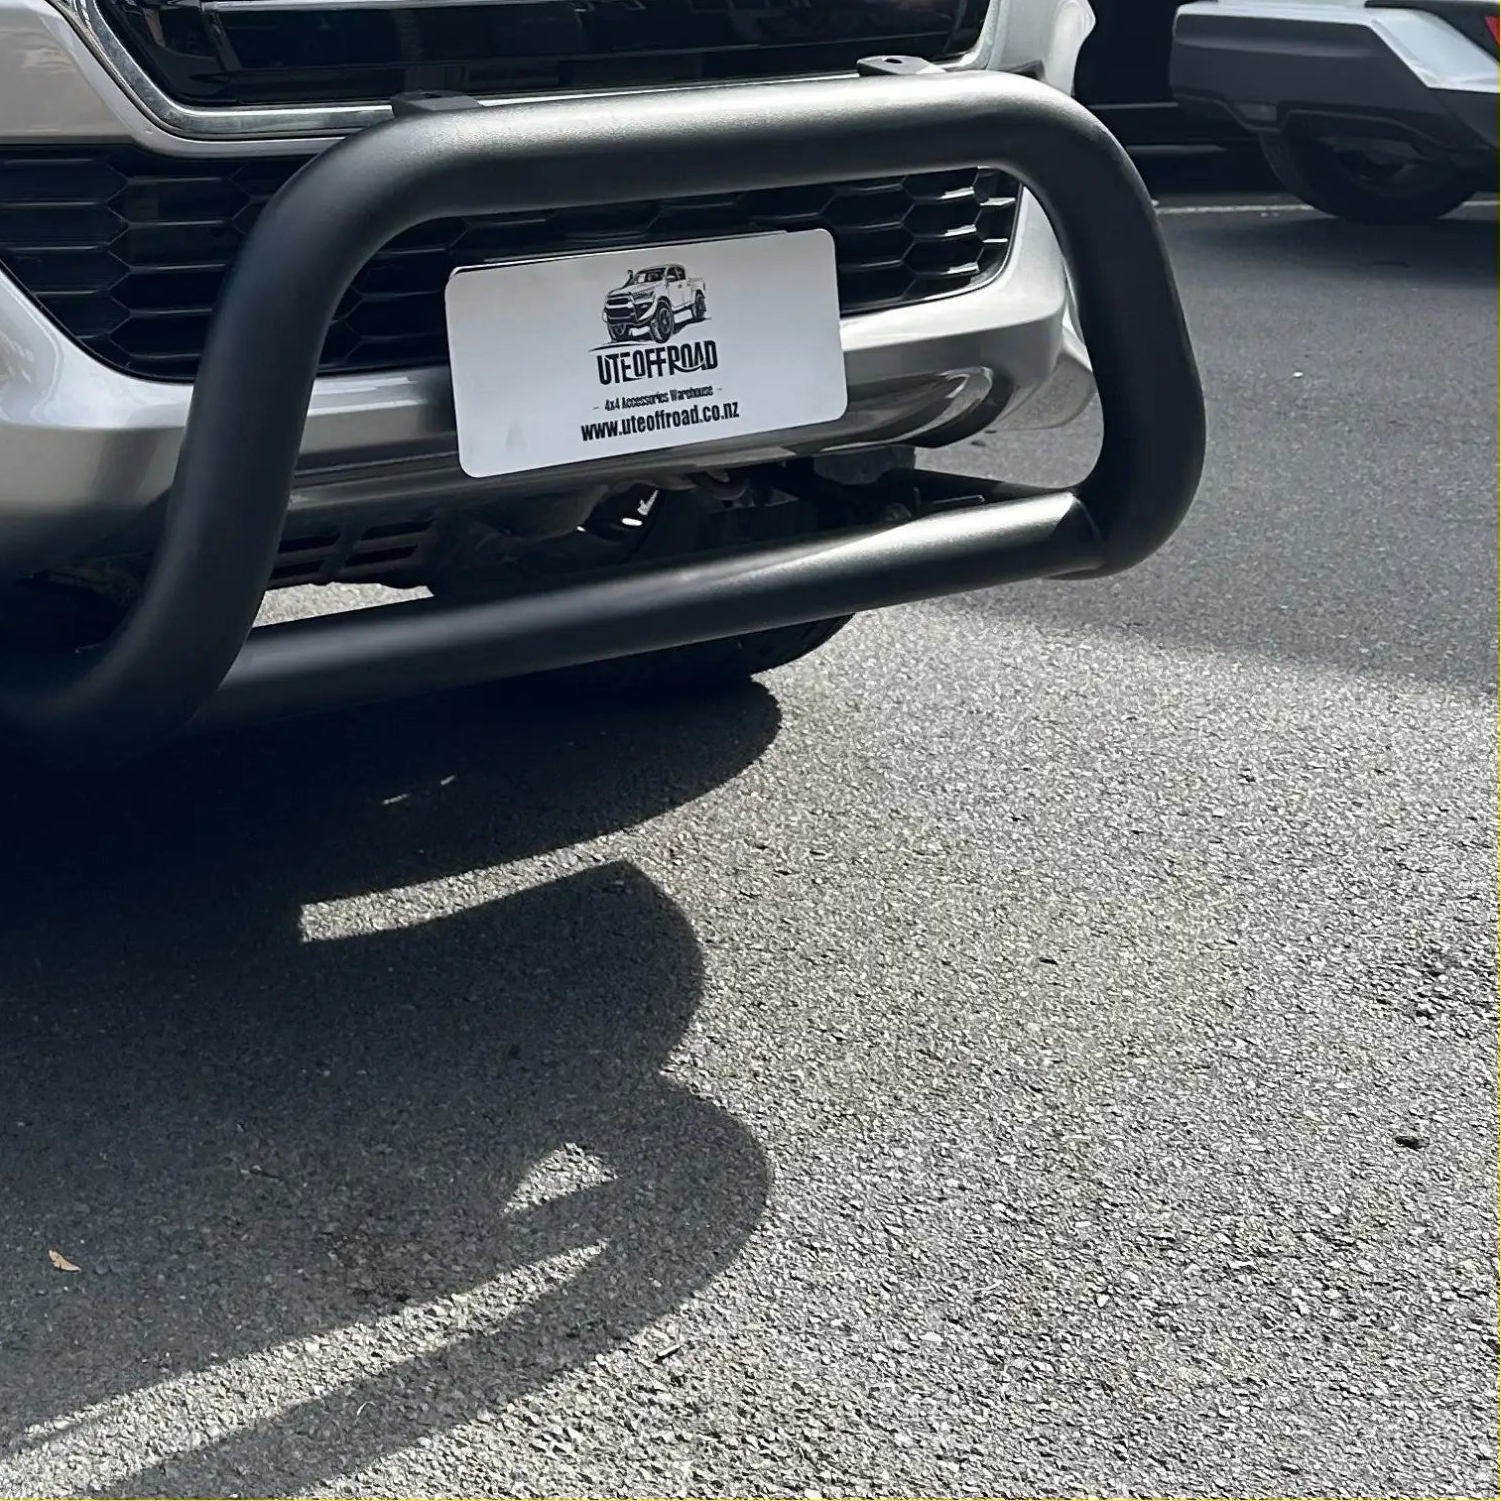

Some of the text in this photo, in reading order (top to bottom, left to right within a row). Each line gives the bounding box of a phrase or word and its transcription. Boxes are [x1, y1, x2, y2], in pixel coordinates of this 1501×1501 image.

[596, 339, 719, 386] UTEOFFROAD
[604, 385, 714, 412] 4x4 Accessories Warehouse
[580, 401, 740, 442] www.uteoffroad.co.nz
